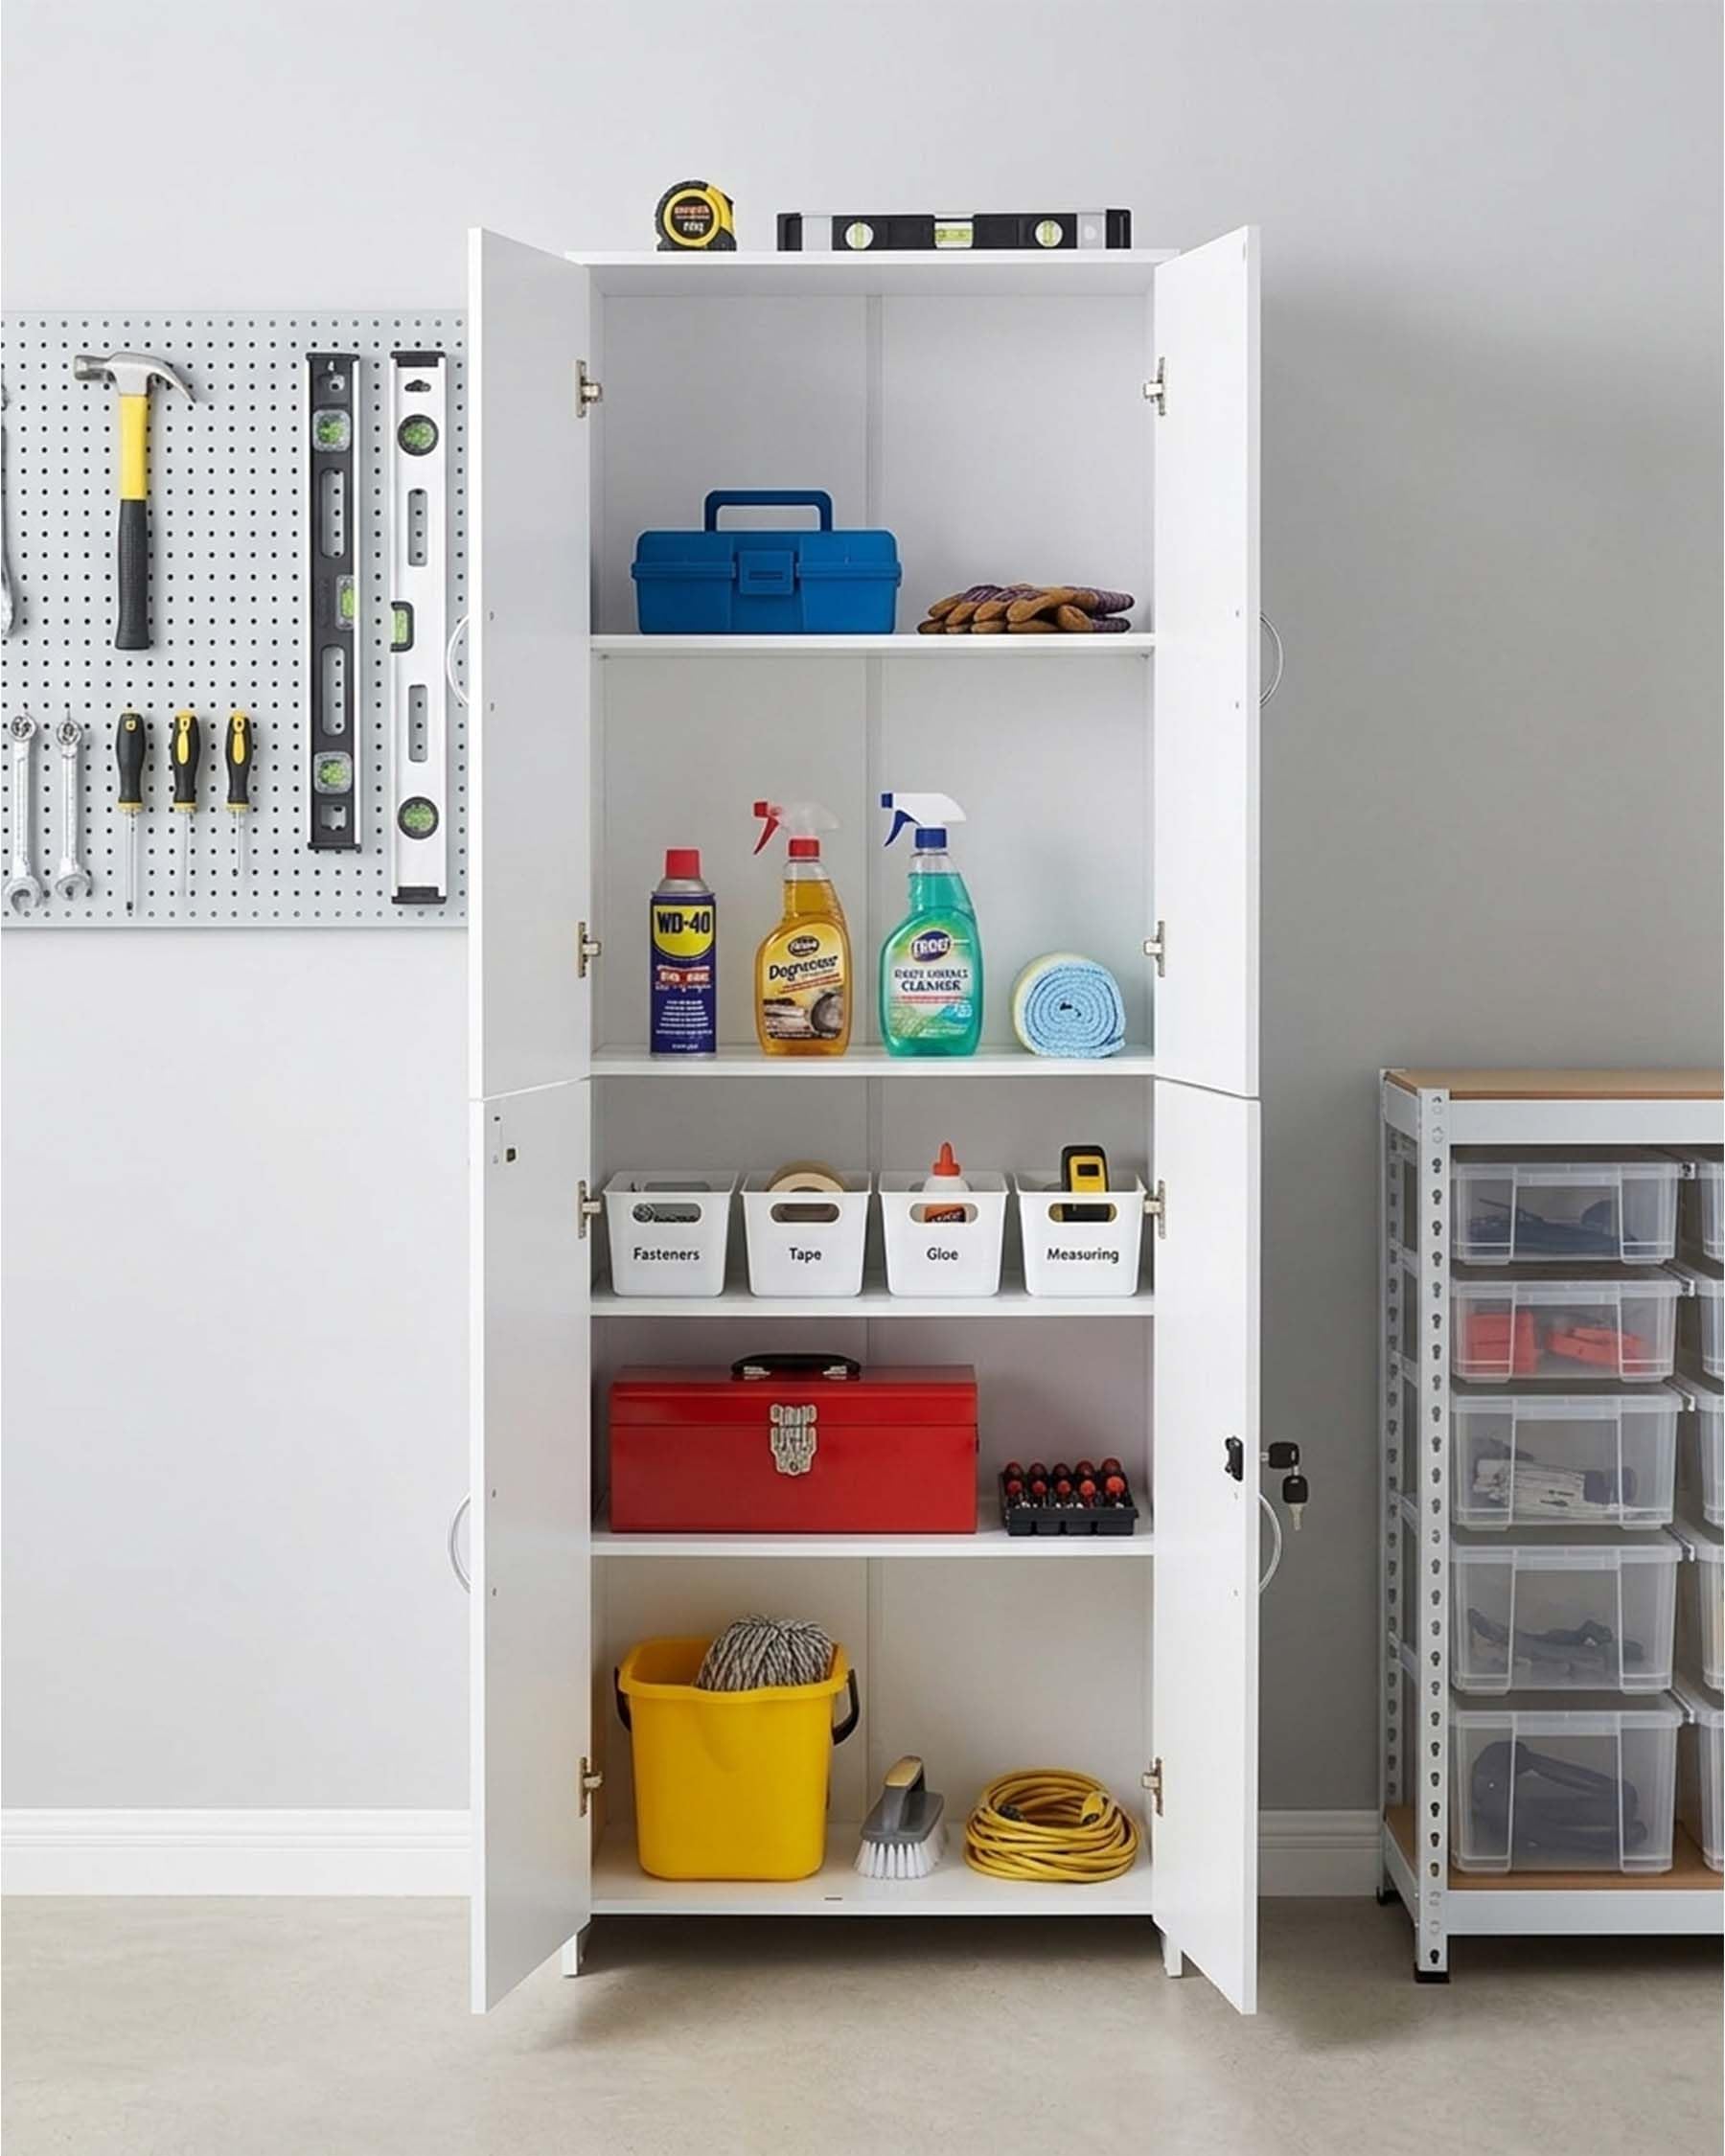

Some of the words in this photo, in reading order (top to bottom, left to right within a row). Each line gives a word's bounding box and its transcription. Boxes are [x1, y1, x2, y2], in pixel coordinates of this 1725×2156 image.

[657, 911, 710, 933] WD-40
[633, 1248, 700, 1261] Fasteners
[789, 1248, 822, 1263] Tape
[1046, 1247, 1119, 1264] Measuring
